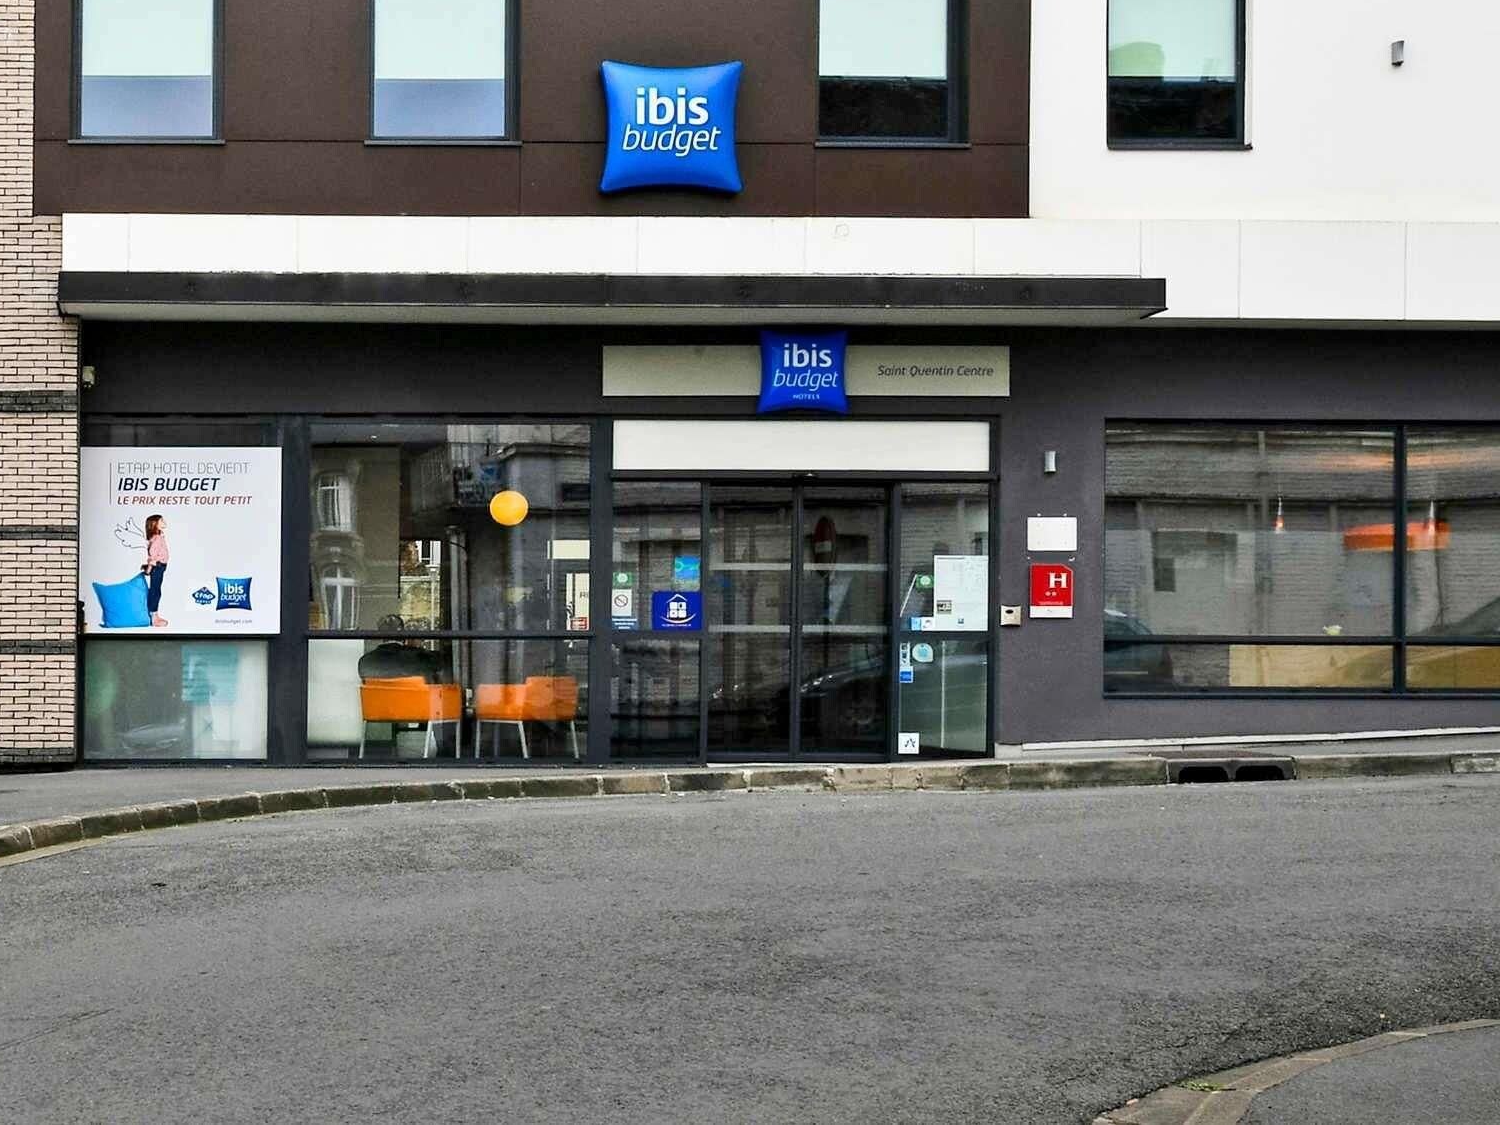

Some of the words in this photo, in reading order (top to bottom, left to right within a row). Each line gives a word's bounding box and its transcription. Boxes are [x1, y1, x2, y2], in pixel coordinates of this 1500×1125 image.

[636, 87, 709, 125] ibis
[622, 124, 722, 157] budget
[783, 343, 833, 368] ibis
[877, 365, 907, 377] Saint
[910, 365, 954, 377] Quentin
[957, 365, 995, 377] Centre
[773, 369, 838, 391] budget
[117, 462, 149, 475] ETAP
[153, 462, 194, 475] HOTEL
[197, 462, 250, 475] DEVIENT
[118, 477, 149, 491] IBIS
[154, 477, 220, 491] BUDGET
[117, 496, 129, 505] LE
[132, 495, 155, 505] PRIX
[158, 495, 191, 505] RESTE
[194, 495, 220, 505] TOUT
[223, 495, 253, 505] PETIT
[1049, 572, 1068, 589] H
[223, 583, 244, 594] ibis
[220, 593, 247, 602] budget
